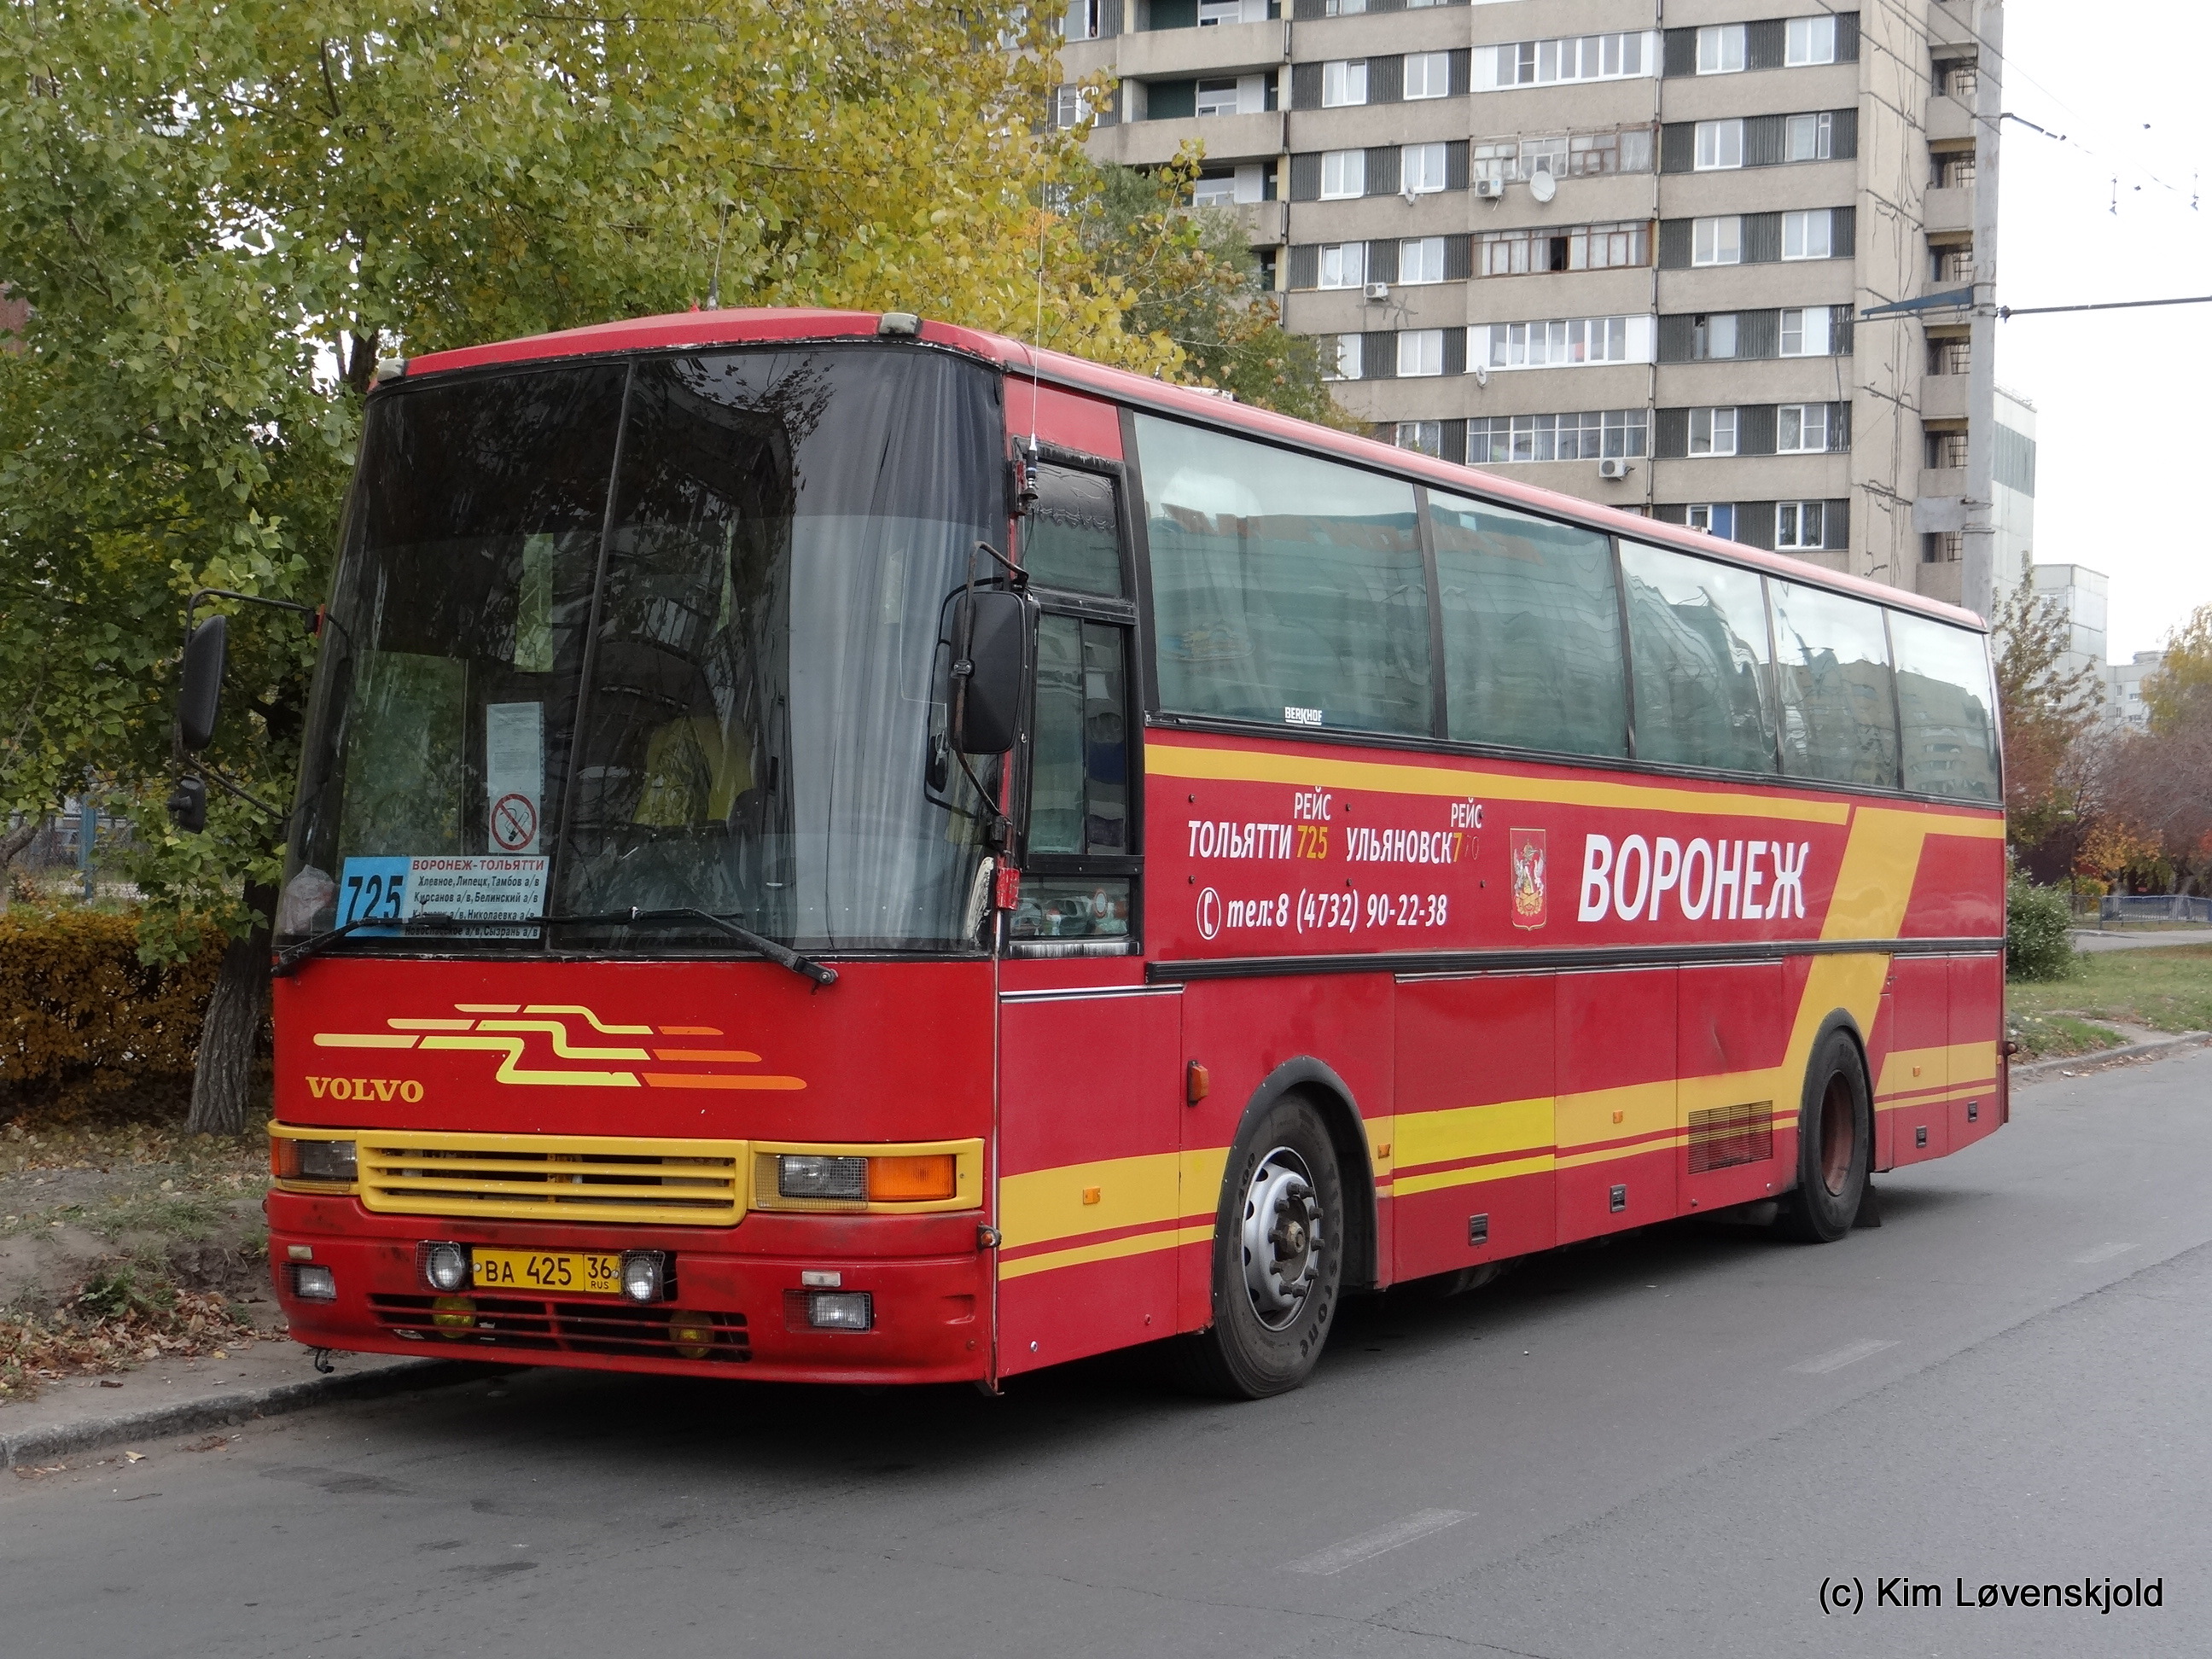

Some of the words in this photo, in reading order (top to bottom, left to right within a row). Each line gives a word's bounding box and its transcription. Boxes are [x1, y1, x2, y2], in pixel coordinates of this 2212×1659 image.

[1284, 707, 1323, 725] BERKHOF
[1294, 786, 1331, 821] РЕЙС
[1450, 797, 1482, 829] РЕЙС
[1188, 820, 1292, 859] ТОЛЬЯТТИ
[1296, 825, 1328, 859] 725
[1346, 827, 1452, 864] УЛЬЯНОВСК
[1577, 834, 1809, 922] ВОРОНЕЖ
[346, 875, 405, 925] 725
[1296, 888, 1359, 934] (4732)
[1365, 894, 1447, 929] 90-22-38
[306, 1076, 424, 1103] VOLVO
[527, 1256, 572, 1286] 425
[587, 1257, 612, 1279] 36
[591, 1281, 609, 1289] RUS
